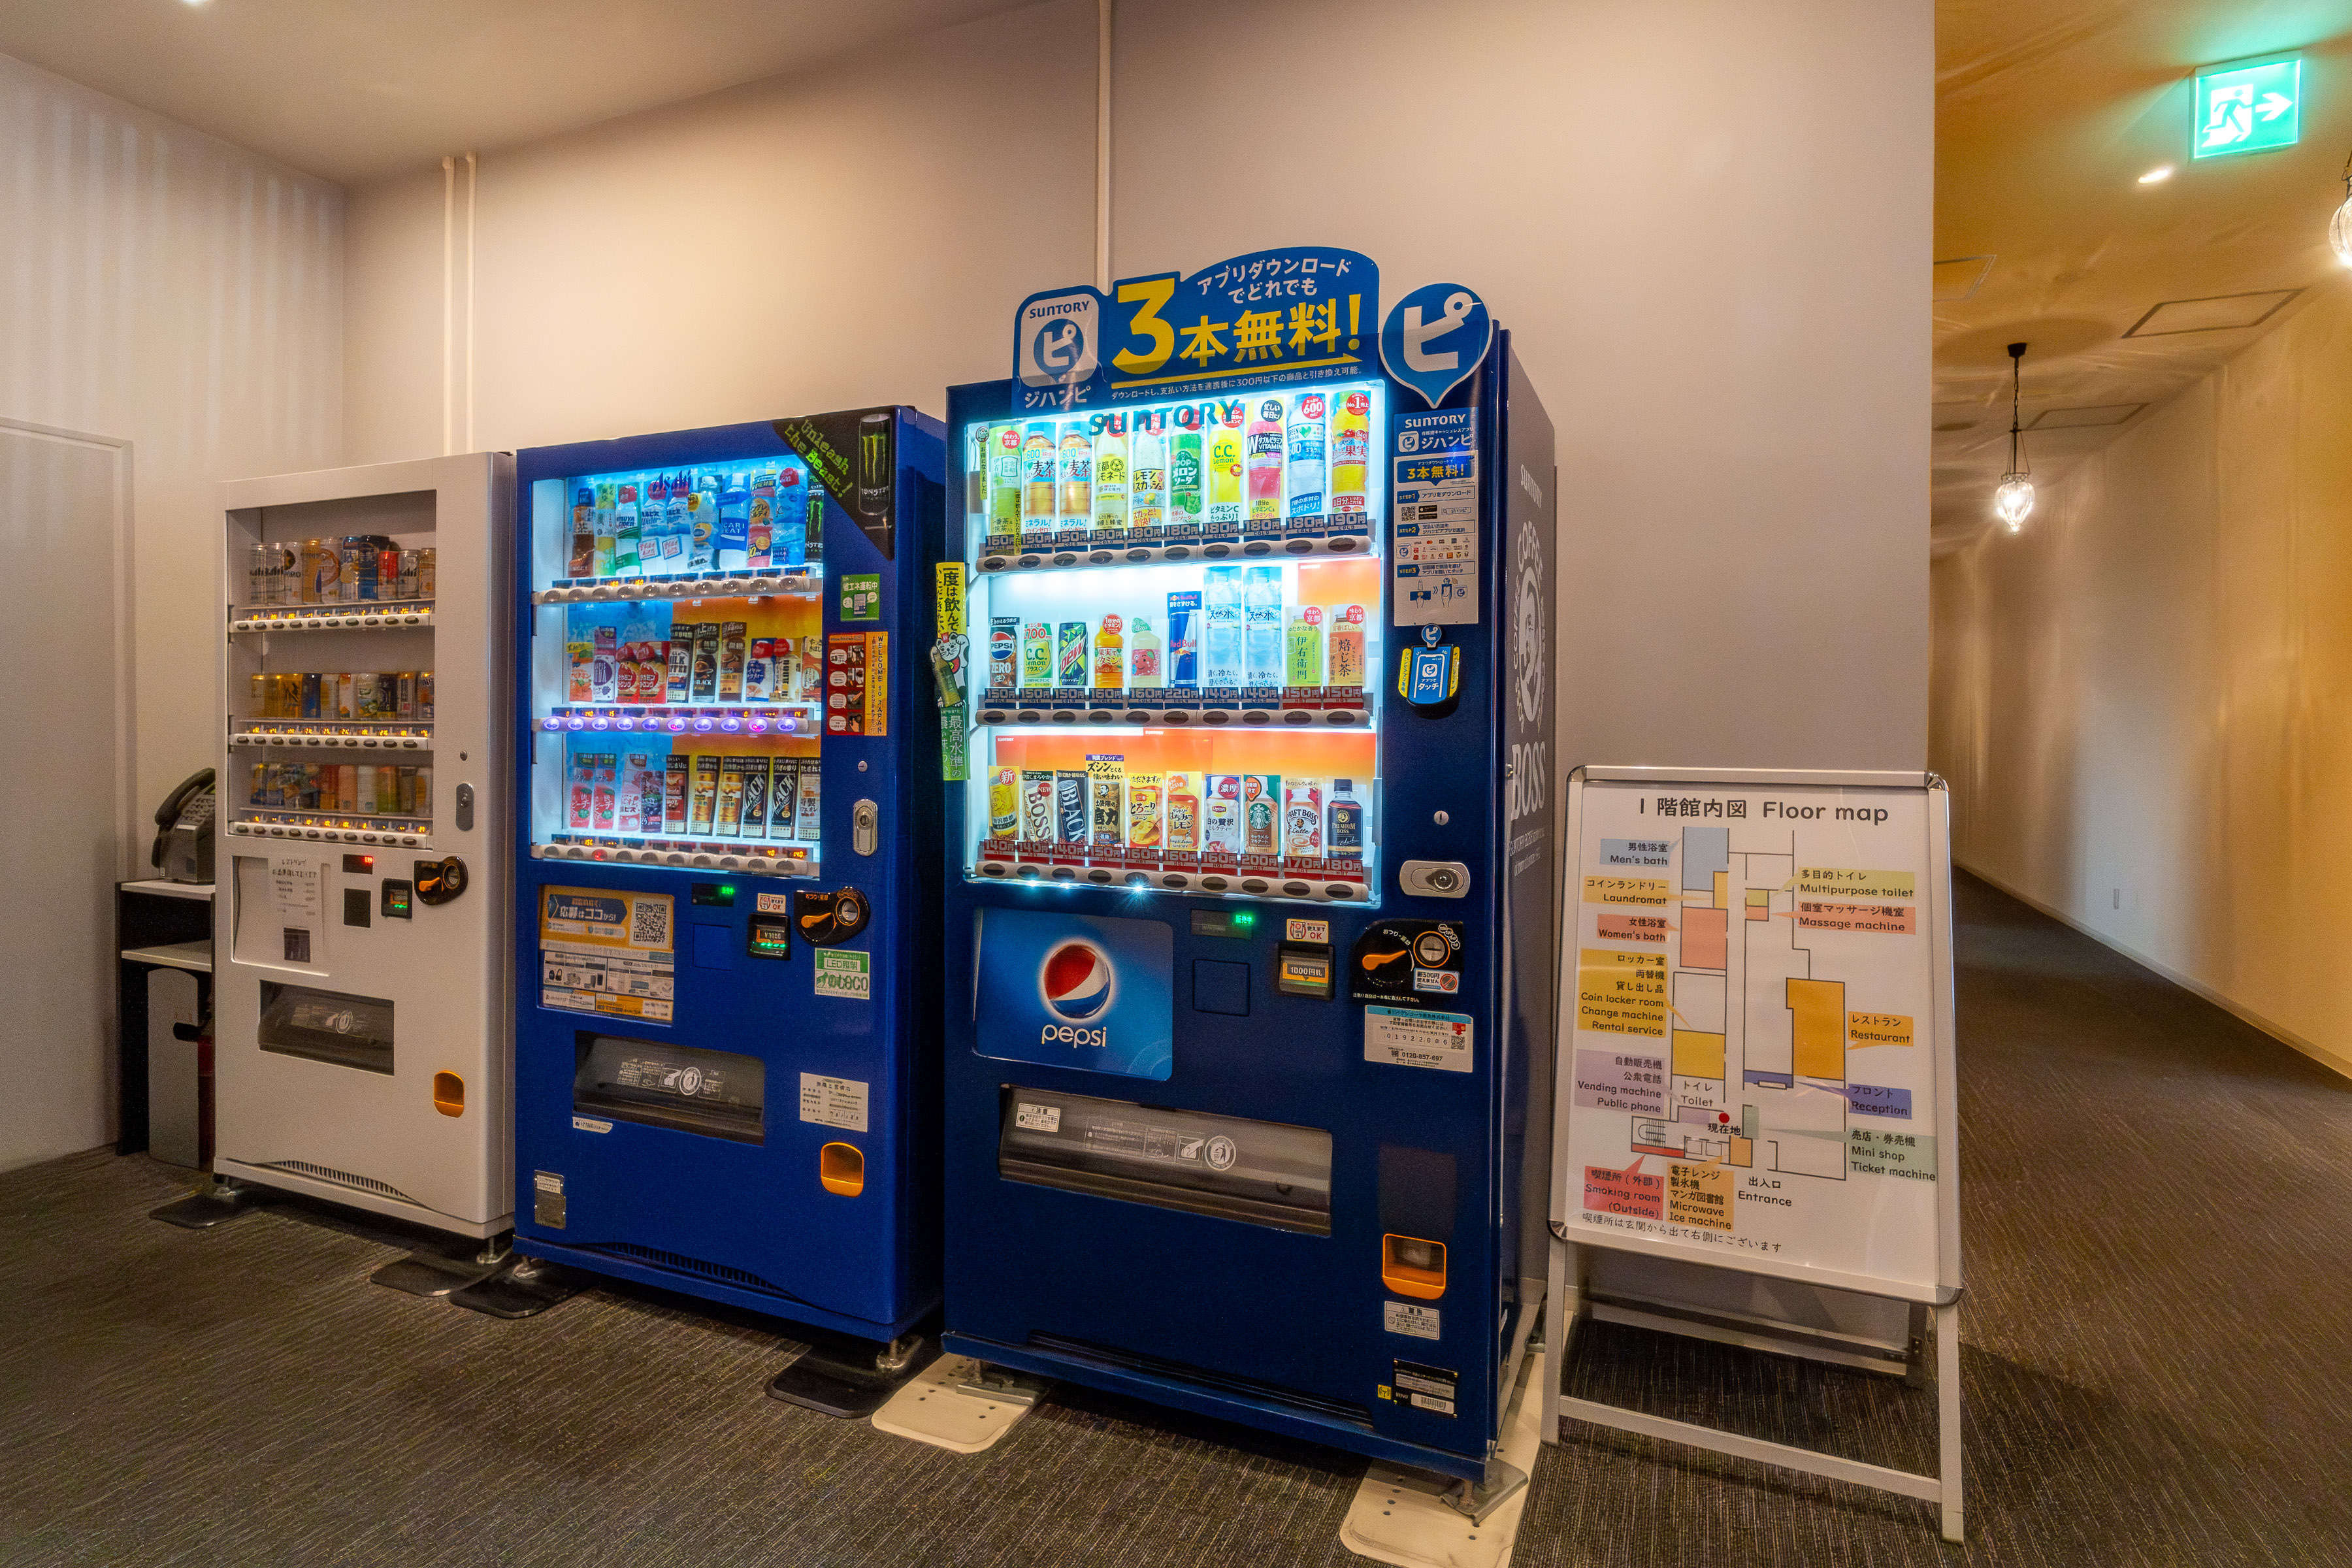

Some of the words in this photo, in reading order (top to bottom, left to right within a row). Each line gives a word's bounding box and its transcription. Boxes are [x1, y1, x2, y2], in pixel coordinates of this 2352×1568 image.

[1198, 259, 1351, 295] アプリダウンロード
[1228, 278, 1317, 304] でどれでも
[1029, 301, 1090, 319] SUNTORY
[1043, 324, 1077, 368] ピ
[1303, 402, 1322, 415] 600
[1088, 399, 1239, 436] SUNTORY
[1405, 414, 1466, 428] SUNTORY
[1422, 434, 1474, 449] ジハンピ
[1026, 449, 1040, 459] 600
[1062, 448, 1076, 458] 600
[1214, 445, 1235, 458] C.C.
[1135, 472, 1156, 481] レモン
[1172, 468, 1197, 478] メロン
[1407, 464, 1464, 479] 3本無料!
[1174, 476, 1195, 485] ソーダ
[1246, 520, 1280, 531] 180円
[1288, 517, 1324, 528] 180円
[1329, 514, 1365, 526] 190円
[1129, 528, 1161, 538] 180円
[1166, 525, 1198, 536] 180円
[1205, 523, 1238, 533] 180円
[1022, 534, 1051, 544] 150円
[1057, 532, 1086, 542] 150円
[1092, 529, 1122, 540] 190円
[943, 566, 960, 632] 一度は飲んで
[1026, 648, 1047, 661] C.C.
[1297, 636, 1307, 679] 伊右衛門
[1339, 639, 1351, 677] 焙じ茶
[992, 662, 1011, 673] ZERO
[988, 689, 1015, 698] 150円
[1021, 689, 1049, 698] 150円
[1054, 689, 1084, 698] 150円
[1091, 689, 1122, 698] 160円
[1131, 689, 1162, 698] 160円
[1165, 689, 1198, 698] 220円
[1205, 689, 1237, 698] 140円
[1243, 689, 1277, 698] 140円
[1284, 687, 1319, 698] 150円
[1324, 687, 1362, 698] 150円
[1002, 771, 1013, 783] 新
[1511, 742, 1545, 821] BOSS
[1028, 791, 1051, 838] BOSS
[1062, 787, 1085, 842] BLACK
[1287, 809, 1302, 824] CRAFT
[1303, 809, 1318, 825] BOSS
[1657, 798, 1746, 819] 階館内図
[1763, 802, 1826, 819] Floor
[1836, 807, 1888, 826] map
[1174, 821, 1193, 830] レモン
[1091, 847, 1119, 857] 150円
[1628, 842, 1668, 852] 男性浴室
[1128, 849, 1157, 860] 160円
[1164, 851, 1196, 861] 160円
[1203, 853, 1236, 864] 160円
[1242, 855, 1277, 866] 200円
[1610, 855, 1640, 864] Men's
[1644, 856, 1667, 865] bath
[1285, 858, 1321, 868] 170円
[1324, 859, 1362, 871] 180円
[1801, 870, 1867, 881] 多目的トイレ
[1587, 880, 1666, 890] コインランドリー
[1800, 884, 1878, 896] Multipurpose
[1882, 889, 1914, 897] toilet
[1603, 893, 1667, 904] Laundromat
[1629, 918, 1666, 928] 女性浴室
[1799, 917, 1851, 928] Massage
[1855, 922, 1905, 931] machine
[1599, 929, 1640, 939] Women's
[1643, 932, 1665, 941] bath
[1618, 955, 1664, 966] ロッカー室
[1616, 981, 1663, 993] 貸し出し品
[1581, 992, 1603, 1001] Coin
[1607, 994, 1636, 1004] locker
[1582, 1006, 1618, 1019] Change
[1622, 1011, 1663, 1021] machine
[1852, 1013, 1901, 1026] レストラン
[1592, 1021, 1624, 1031] Rental
[1627, 1025, 1663, 1035] service
[1041, 1024, 1107, 1048] pepsi
[1851, 1030, 1910, 1043] Restaurant
[1615, 1056, 1662, 1070] 自動販売機
[1578, 1081, 1617, 1094] Vending
[1620, 1086, 1661, 1098] machine
[1684, 1080, 1712, 1092] トイレ
[1598, 1097, 1627, 1108] Public
[1631, 1102, 1661, 1113] phone
[1680, 1094, 1713, 1107] Toilet
[1852, 1101, 1908, 1116] Reception
[1707, 1123, 1741, 1135] 現在地
[1852, 1146, 1875, 1157] Mini
[1879, 1150, 1904, 1162] shop
[1671, 1165, 1721, 1180] 電子レンジ
[1852, 1162, 1885, 1174] Ticket
[1889, 1169, 1936, 1181] machine
[1748, 1177, 1781, 1189] 出入口
[1586, 1184, 1630, 1200] Smoking
[1634, 1192, 1660, 1203] room
[1739, 1190, 1792, 1207] Entrance
[1609, 1202, 1659, 1220] (Outside)
[1670, 1200, 1724, 1217] Microwave
[1669, 1212, 1685, 1223] Ice
[1688, 1215, 1731, 1230] machine
